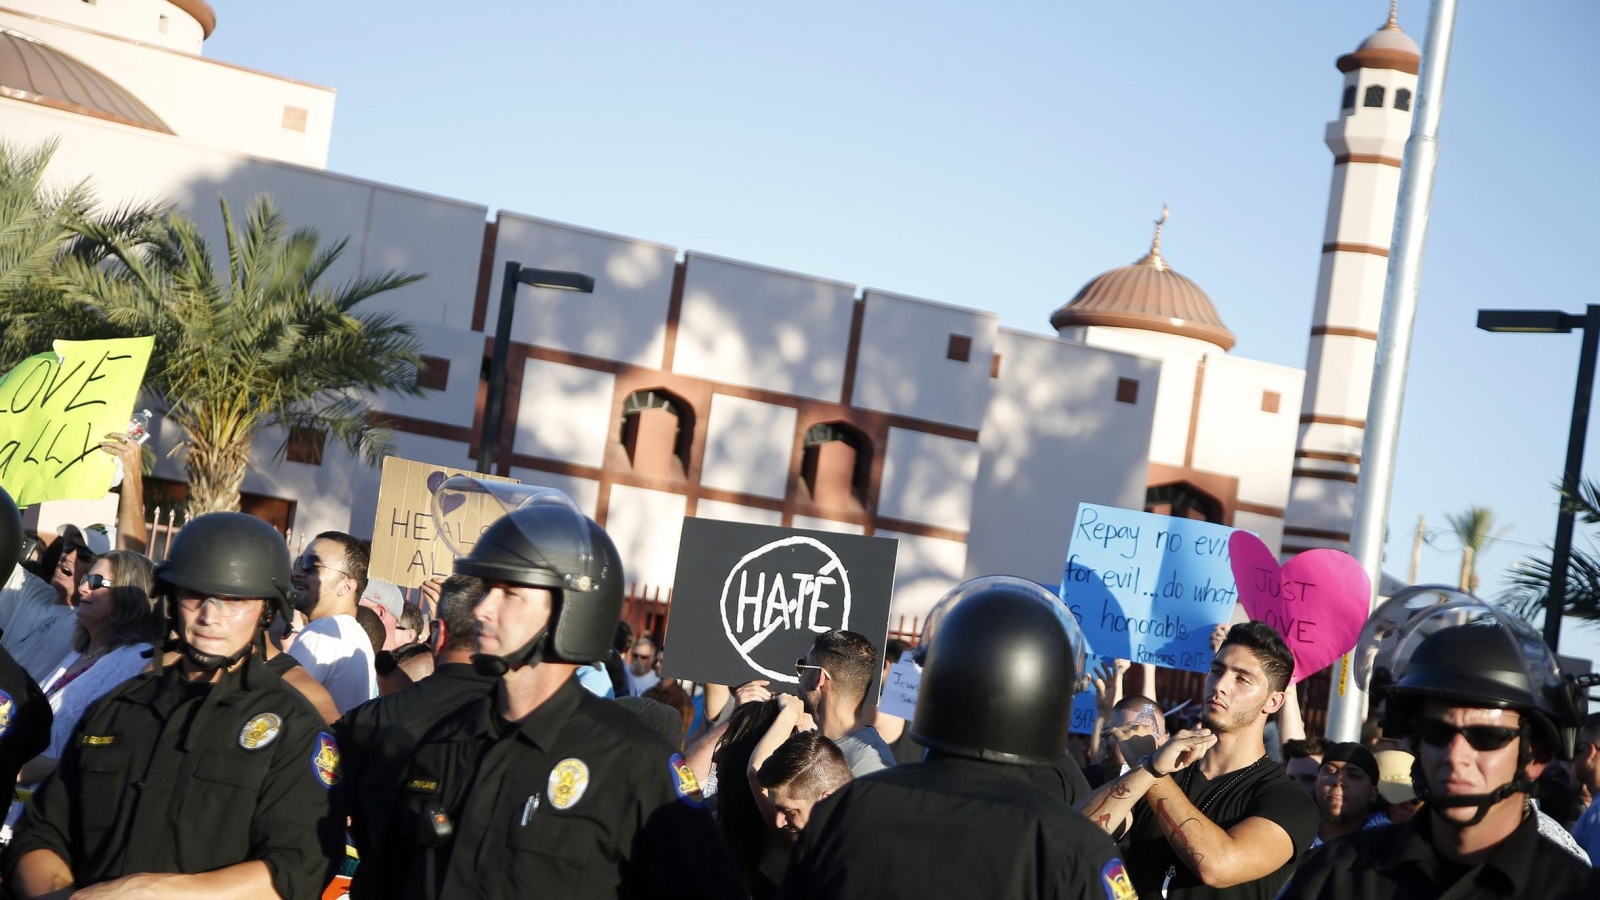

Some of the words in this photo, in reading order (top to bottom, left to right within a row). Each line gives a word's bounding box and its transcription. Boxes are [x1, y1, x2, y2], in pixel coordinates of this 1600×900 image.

[0, 351, 132, 413] OVE
[1076, 508, 1141, 559] Repay
[1156, 530, 1183, 552] no
[407, 550, 456, 577] AL
[1066, 554, 1096, 582] for
[1194, 578, 1236, 605] what
[1254, 567, 1317, 602] JUST
[736, 570, 837, 633] HATE
[1101, 599, 1190, 641] honorable
[1136, 643, 1176, 664] Romans
